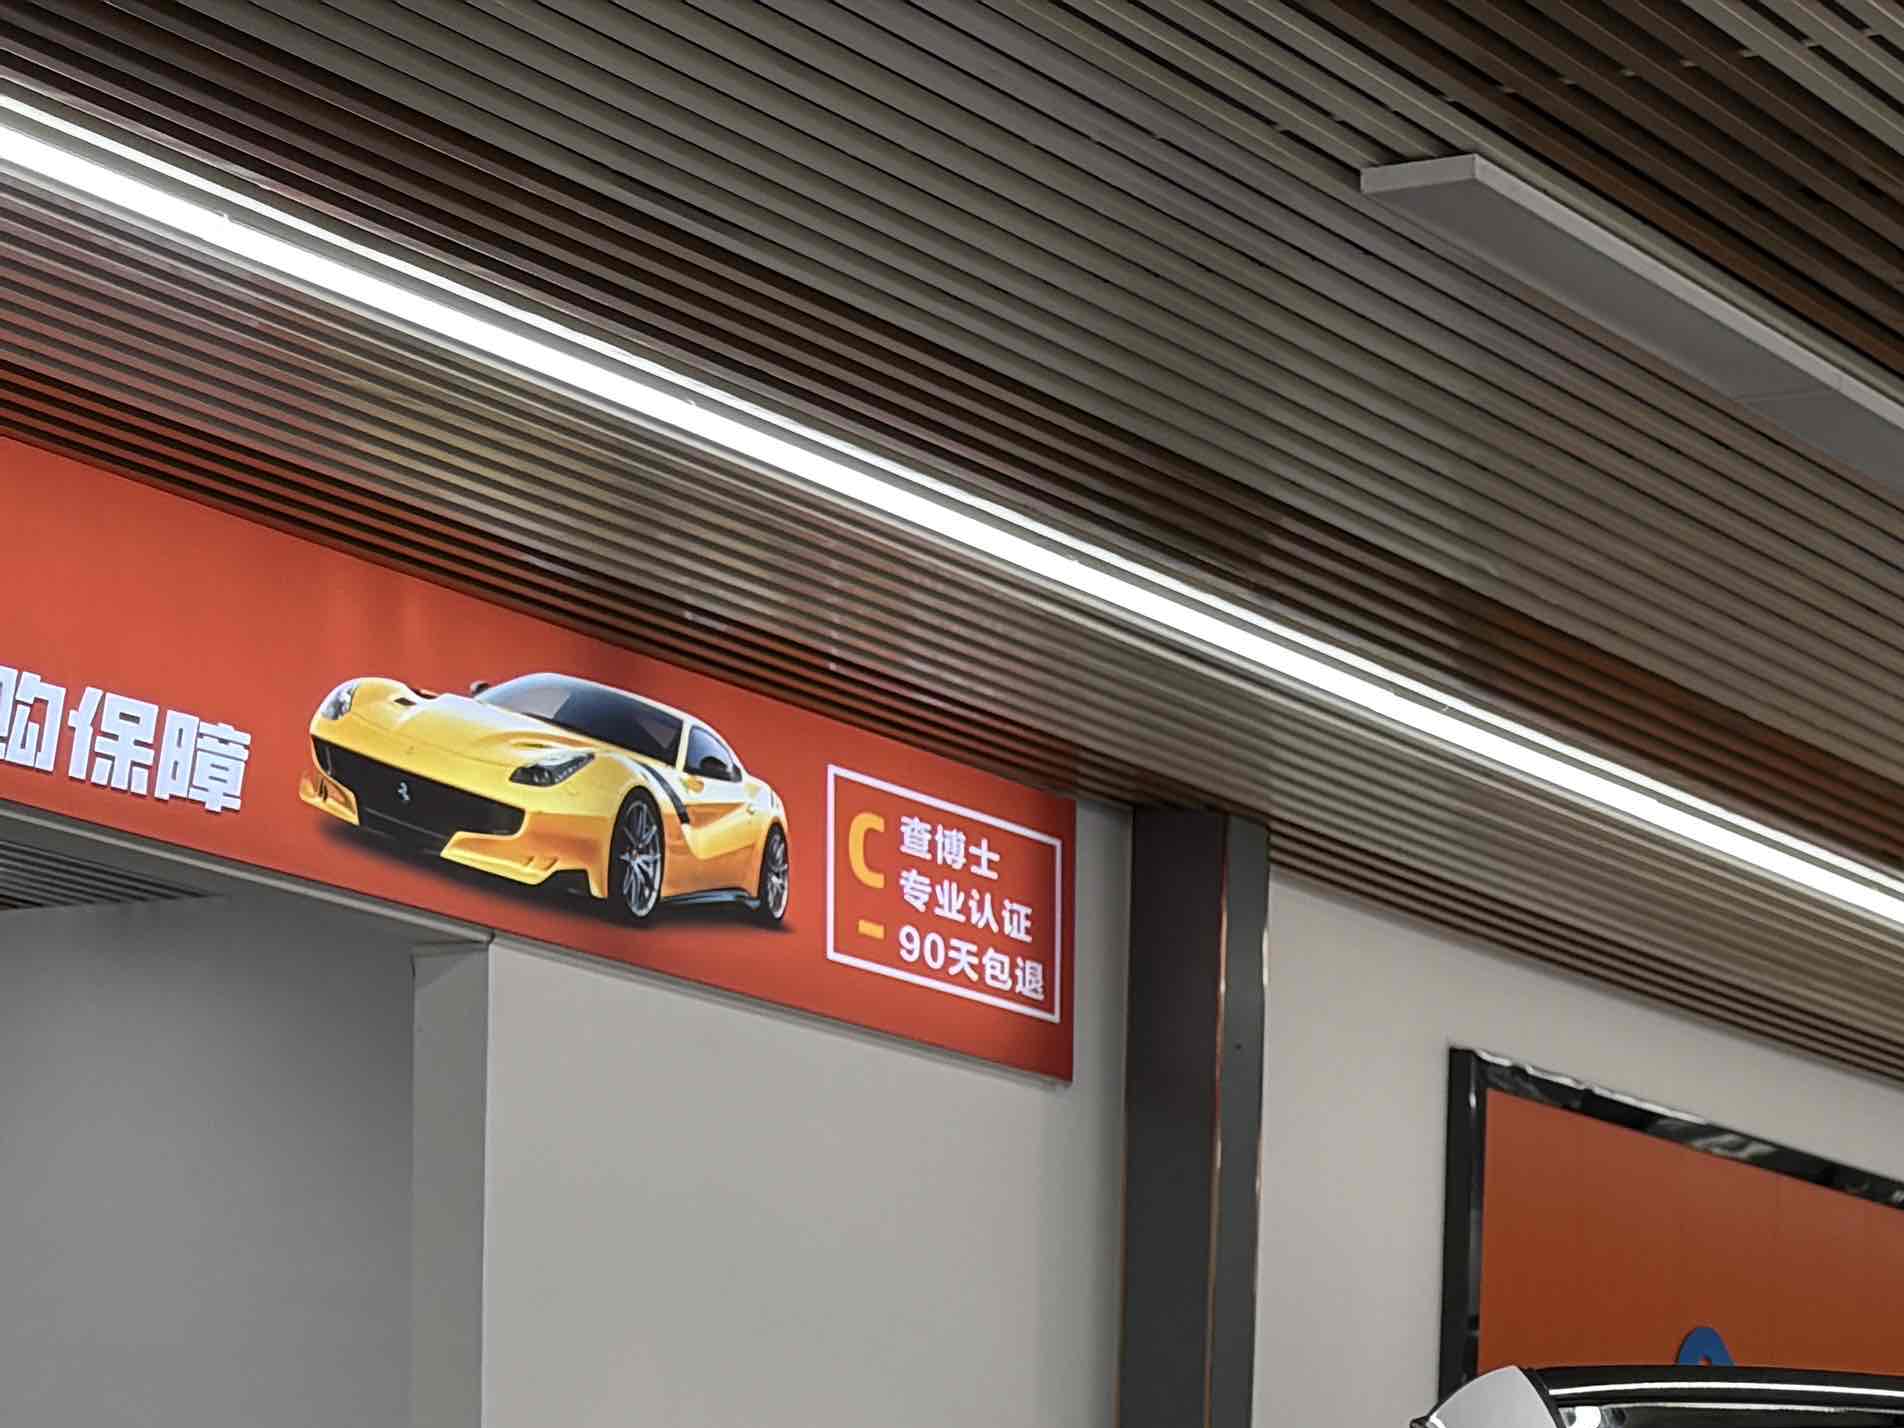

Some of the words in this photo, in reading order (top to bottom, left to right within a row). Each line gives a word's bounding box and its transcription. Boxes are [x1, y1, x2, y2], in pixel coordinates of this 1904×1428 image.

[0, 665, 251, 813] 购保障
[899, 815, 1001, 881] 查博士
[899, 868, 1033, 944] 专业认证
[898, 923, 1046, 1001] 90天包退
